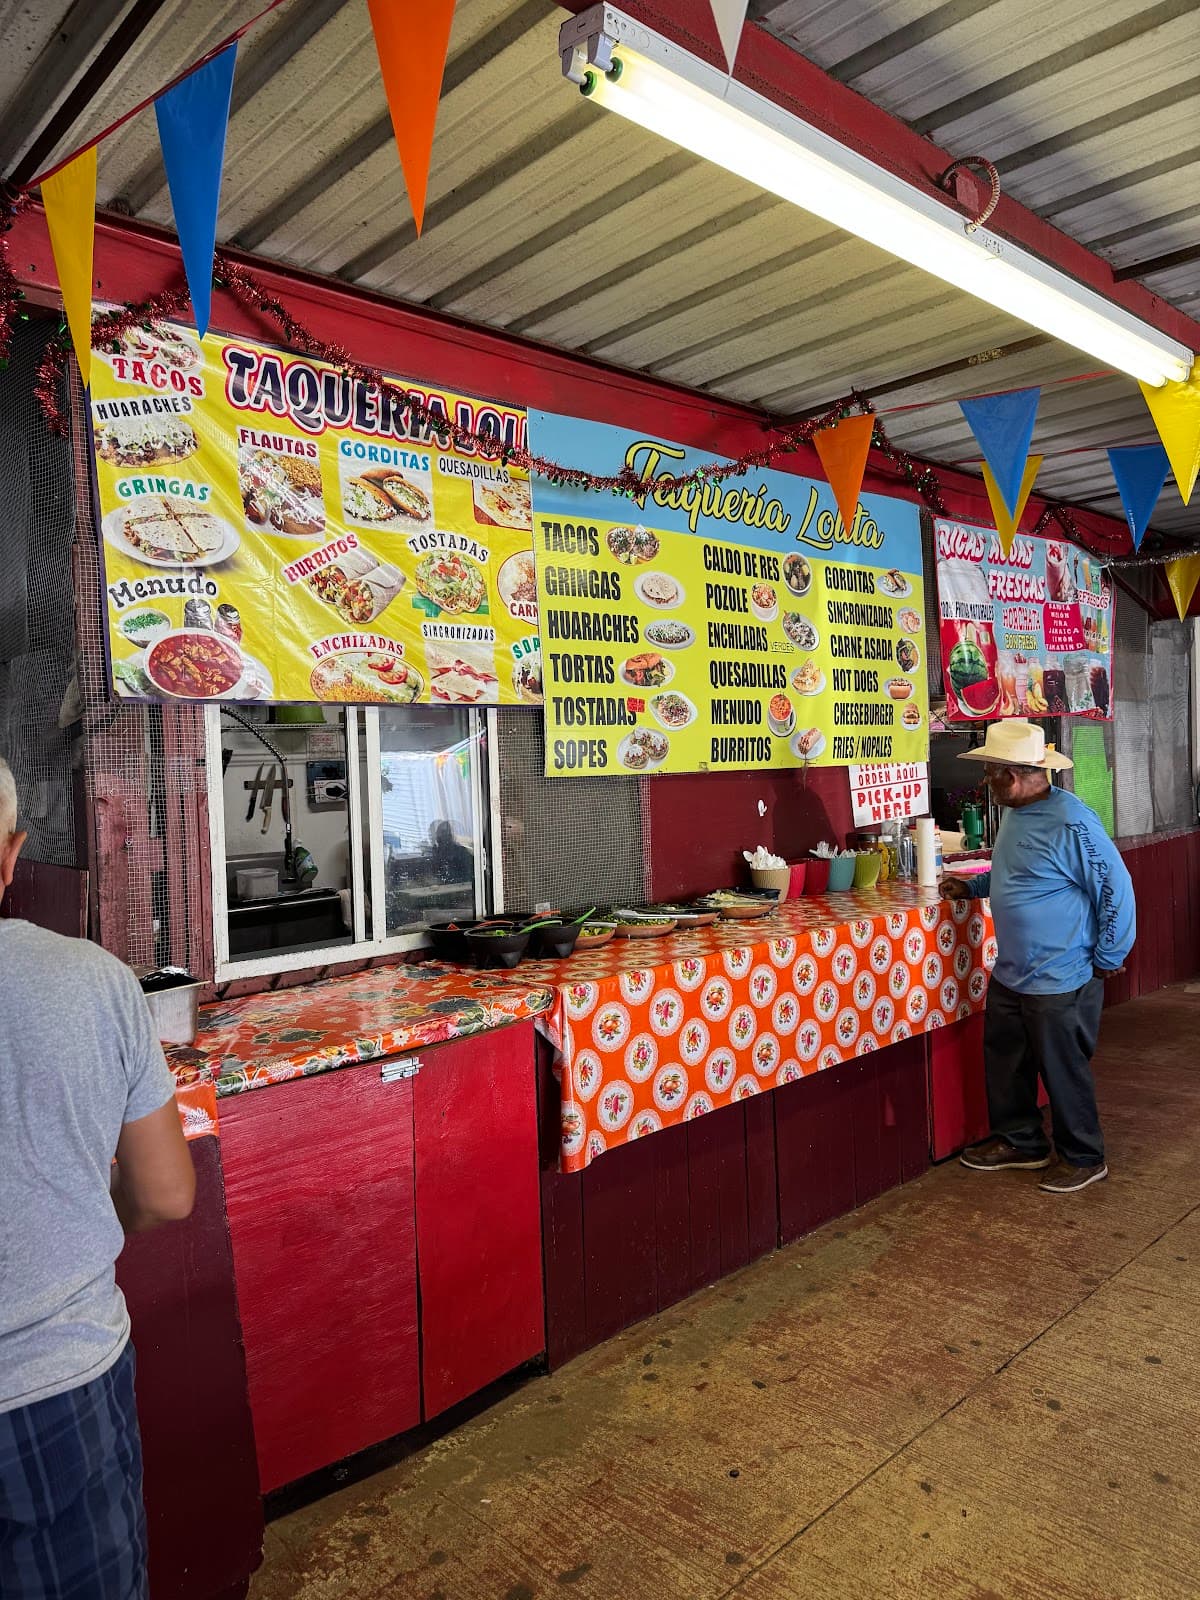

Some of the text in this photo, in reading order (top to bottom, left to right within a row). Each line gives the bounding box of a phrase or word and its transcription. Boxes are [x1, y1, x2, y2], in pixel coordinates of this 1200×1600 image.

[113, 358, 203, 396] TACOS
[97, 396, 191, 420] HUARACHES
[240, 429, 317, 457] FLAUTAS
[455, 402, 527, 466] LOL
[341, 441, 430, 471] GORDITAS
[440, 457, 509, 484] QUESADILLAS
[118, 478, 209, 501] GRINGAS
[409, 533, 488, 563] TOSTADAS
[541, 521, 599, 556] TACOS
[938, 525, 986, 562] RICAS
[284, 533, 358, 583] BURRITOS
[703, 543, 780, 582] CALDO DE RES
[109, 572, 217, 608] Menudo
[544, 565, 621, 601] GRINGAS
[825, 566, 875, 595] GORDITAS
[988, 569, 1046, 604] FRESCAS
[706, 583, 749, 613] POZOLE
[547, 609, 639, 644] HUARACHES
[827, 600, 893, 629] SINCRONIZADAS
[1003, 607, 1040, 631] HORCHATA
[311, 635, 403, 659] ENCHILADAS
[423, 625, 494, 641] SINCRONIZADAS
[708, 622, 768, 652] ENCHILADAS
[830, 634, 893, 661] CARNE ASADA
[550, 653, 615, 684] TORTAS
[710, 660, 787, 689] QUESADILLAS
[833, 669, 878, 693] HOT DOGS
[552, 697, 637, 726] TOSTADAS
[711, 699, 762, 725] MENUDO
[834, 702, 894, 726] CHEESEBURGER
[554, 739, 607, 770] SOPES
[711, 737, 771, 763] BURRITOS
[833, 736, 854, 759] FRIES
[861, 736, 892, 758] NOPALES
[858, 766, 918, 786] ORDEN AQUI
[857, 783, 921, 807] PICK-UP
[1065, 820, 1099, 859] Bimini
[1100, 885, 1119, 945] Outfitters
